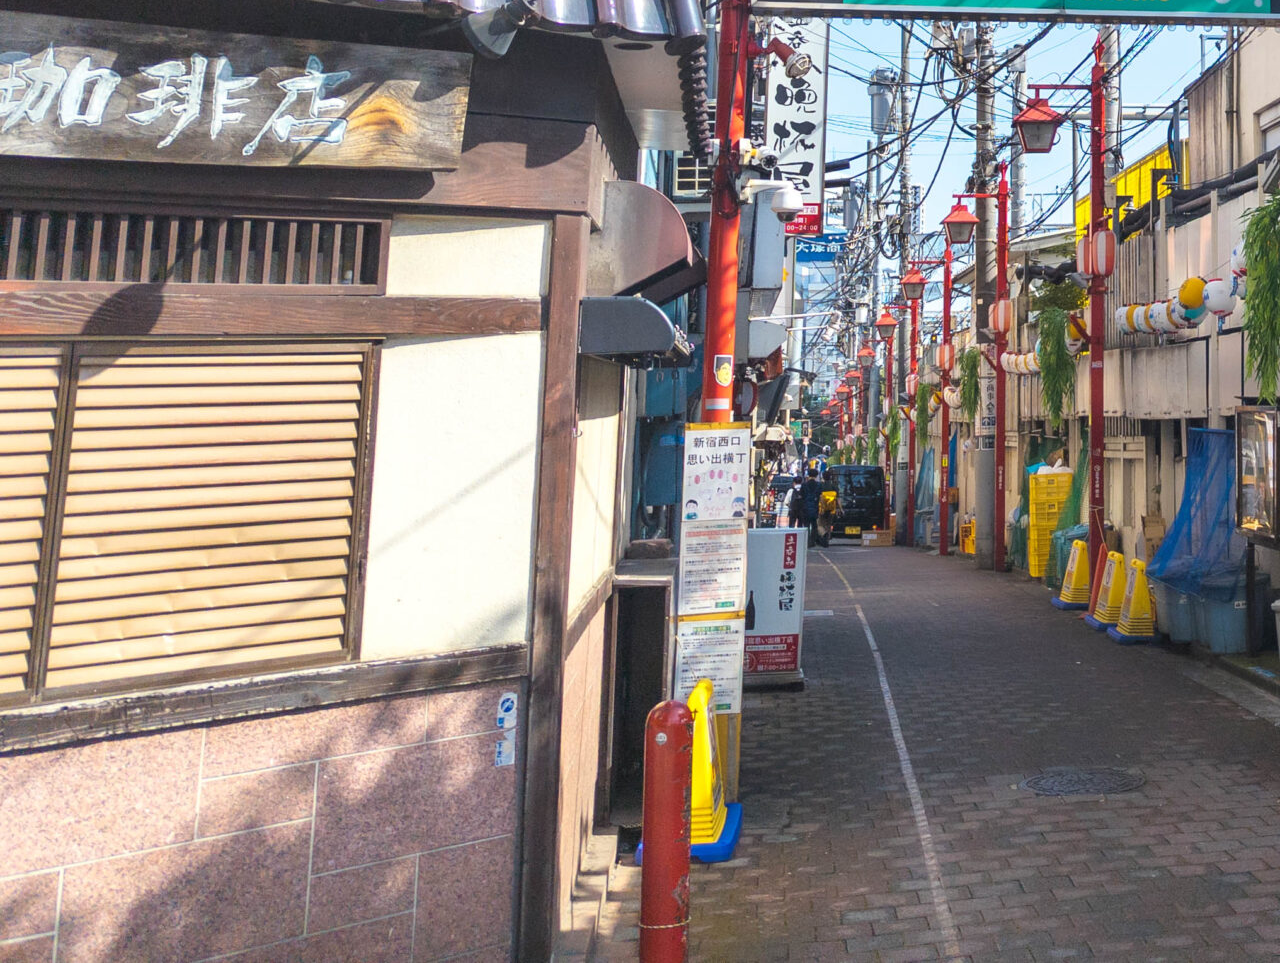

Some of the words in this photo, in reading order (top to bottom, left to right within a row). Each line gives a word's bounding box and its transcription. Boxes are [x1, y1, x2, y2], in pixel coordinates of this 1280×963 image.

[693, 436, 741, 448] 新宿西口
[687, 453, 747, 465] 思い出横丁
